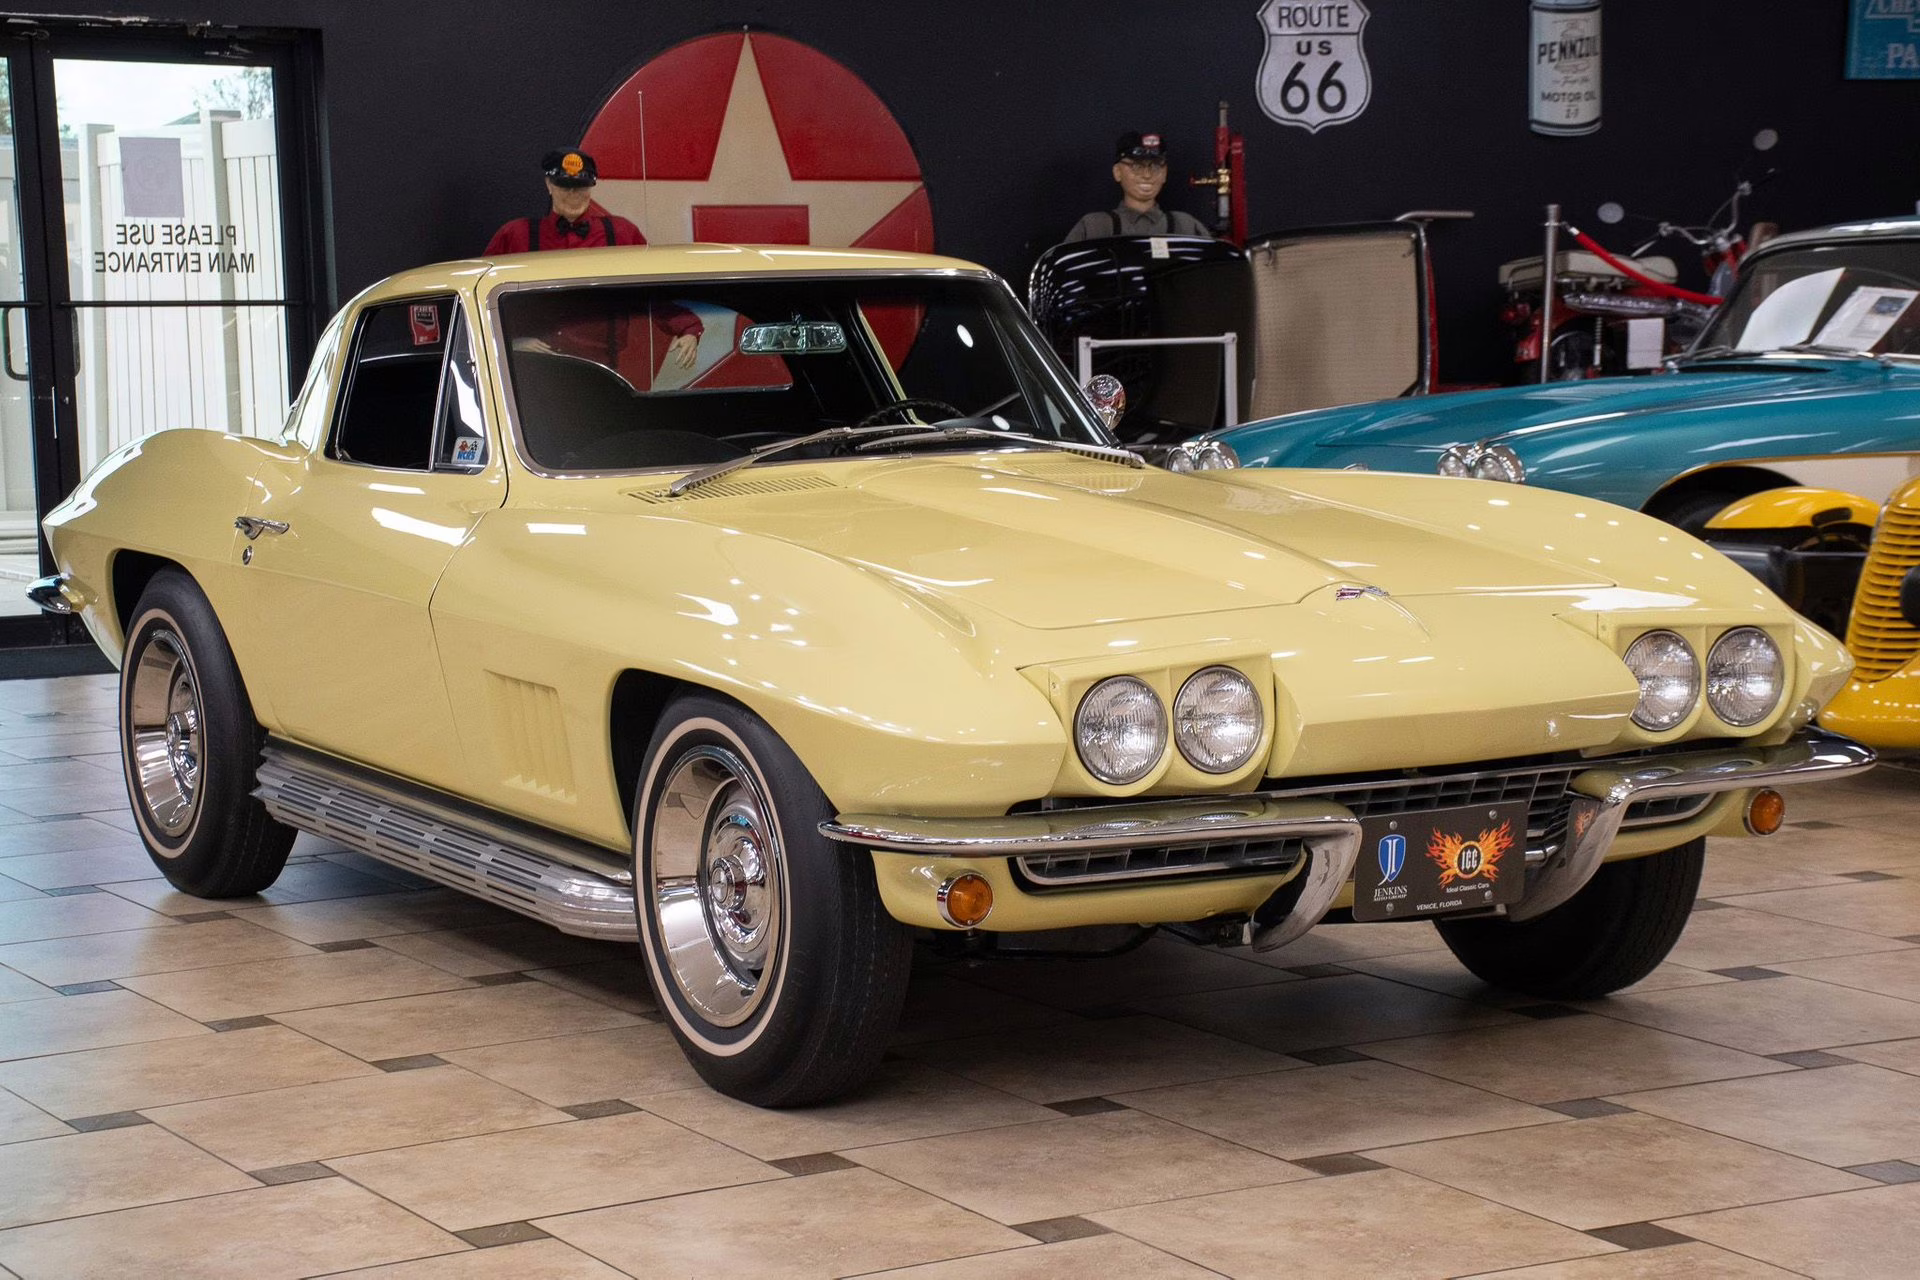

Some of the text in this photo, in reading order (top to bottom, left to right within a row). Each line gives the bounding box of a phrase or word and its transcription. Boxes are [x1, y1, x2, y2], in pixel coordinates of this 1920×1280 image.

[1278, 5, 1350, 28] ROUTE
[1296, 40, 1333, 56] US
[1281, 60, 1347, 115] 66
[1541, 91, 1581, 103] MOTOR
[1461, 848, 1478, 871] ICC
[1373, 885, 1408, 898] JENKINS
[1446, 882, 1490, 894] Ideal Classic Cars
[1416, 899, 1463, 911] VENICE, FLORIDA
